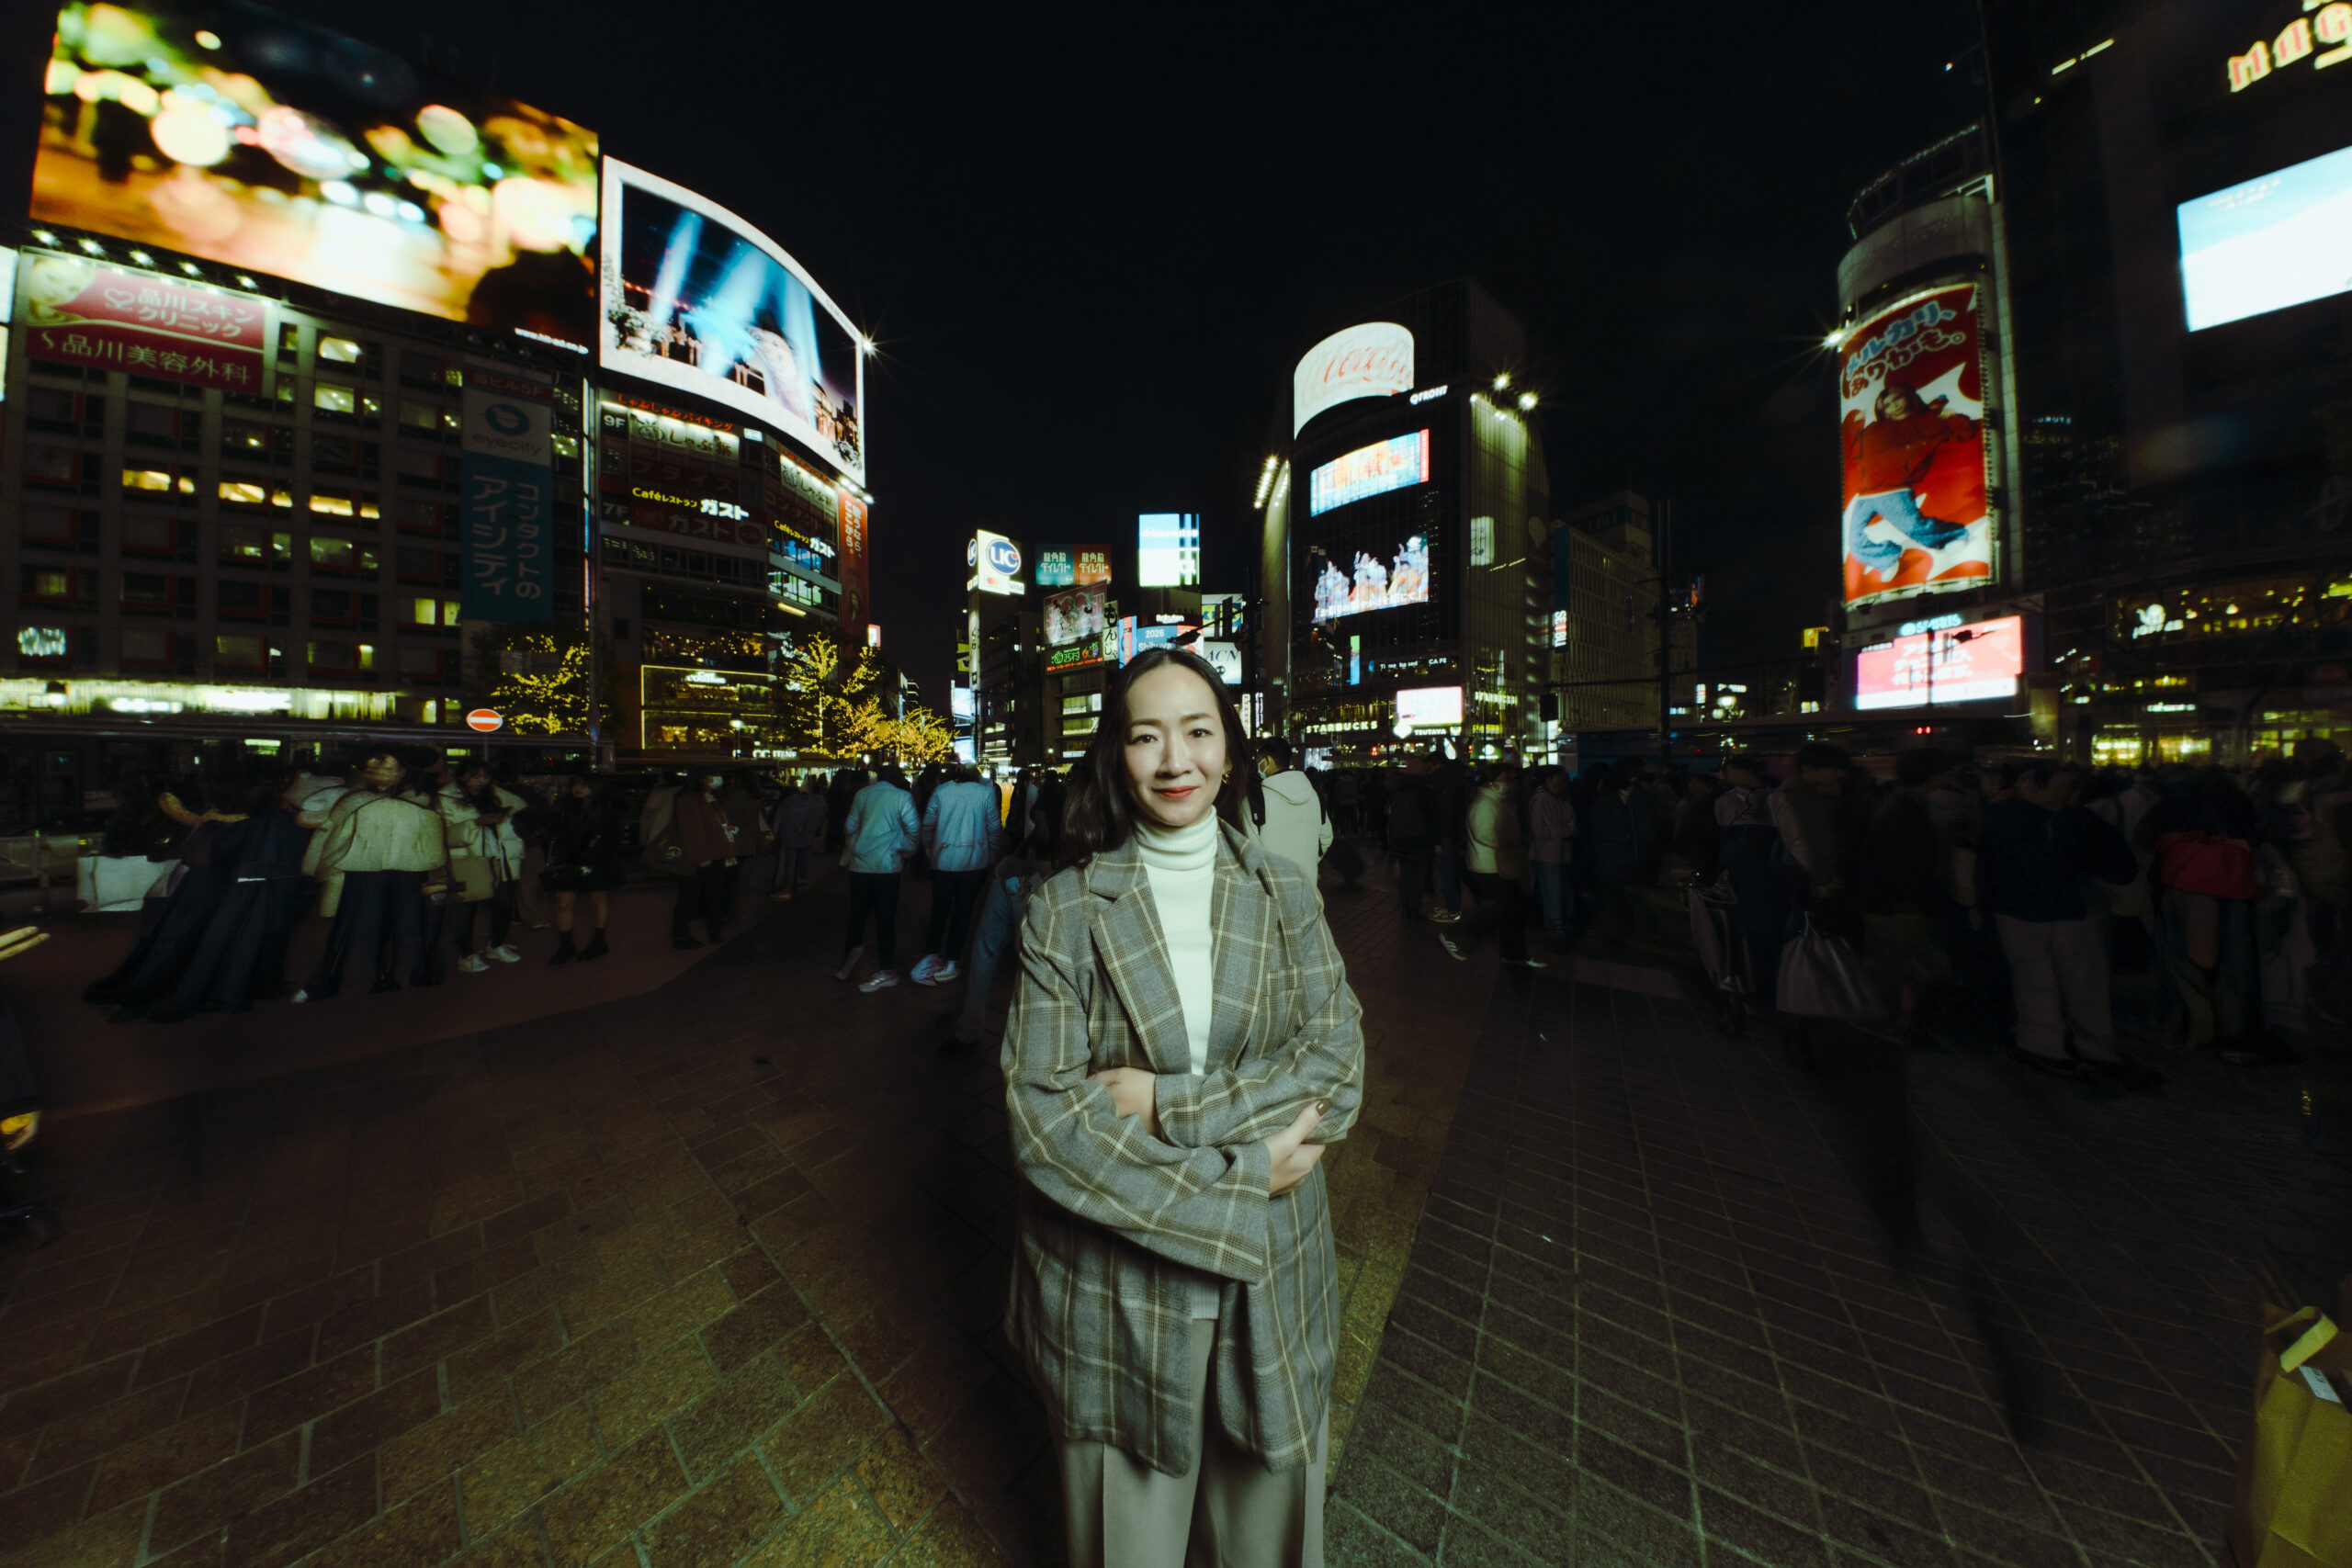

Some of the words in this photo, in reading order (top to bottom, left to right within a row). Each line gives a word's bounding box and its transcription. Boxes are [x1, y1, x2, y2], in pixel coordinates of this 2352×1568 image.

[139, 288, 255, 322] 品川スキン
[138, 307, 242, 337] クリニック
[62, 334, 251, 385] 品川美容外科
[1409, 385, 1448, 405] QFRONT
[604, 414, 626, 428] 9F
[473, 434, 541, 457] eyecity
[603, 502, 629, 518] 7F
[700, 498, 750, 521] ガスト
[471, 474, 508, 596] アイシティ
[515, 482, 542, 600] コンタクトの
[810, 536, 835, 558] ガスト
[990, 546, 1018, 568] UC
[1040, 563, 1070, 573] ダイレクト
[1079, 563, 1109, 573] ダイレクト
[1156, 614, 1184, 623] Rakuten
[1104, 604, 1118, 659] もんじゃ
[1146, 628, 1165, 637] 2026
[1204, 649, 1240, 661] ACN
[1306, 721, 1378, 734] STARBUCKS
